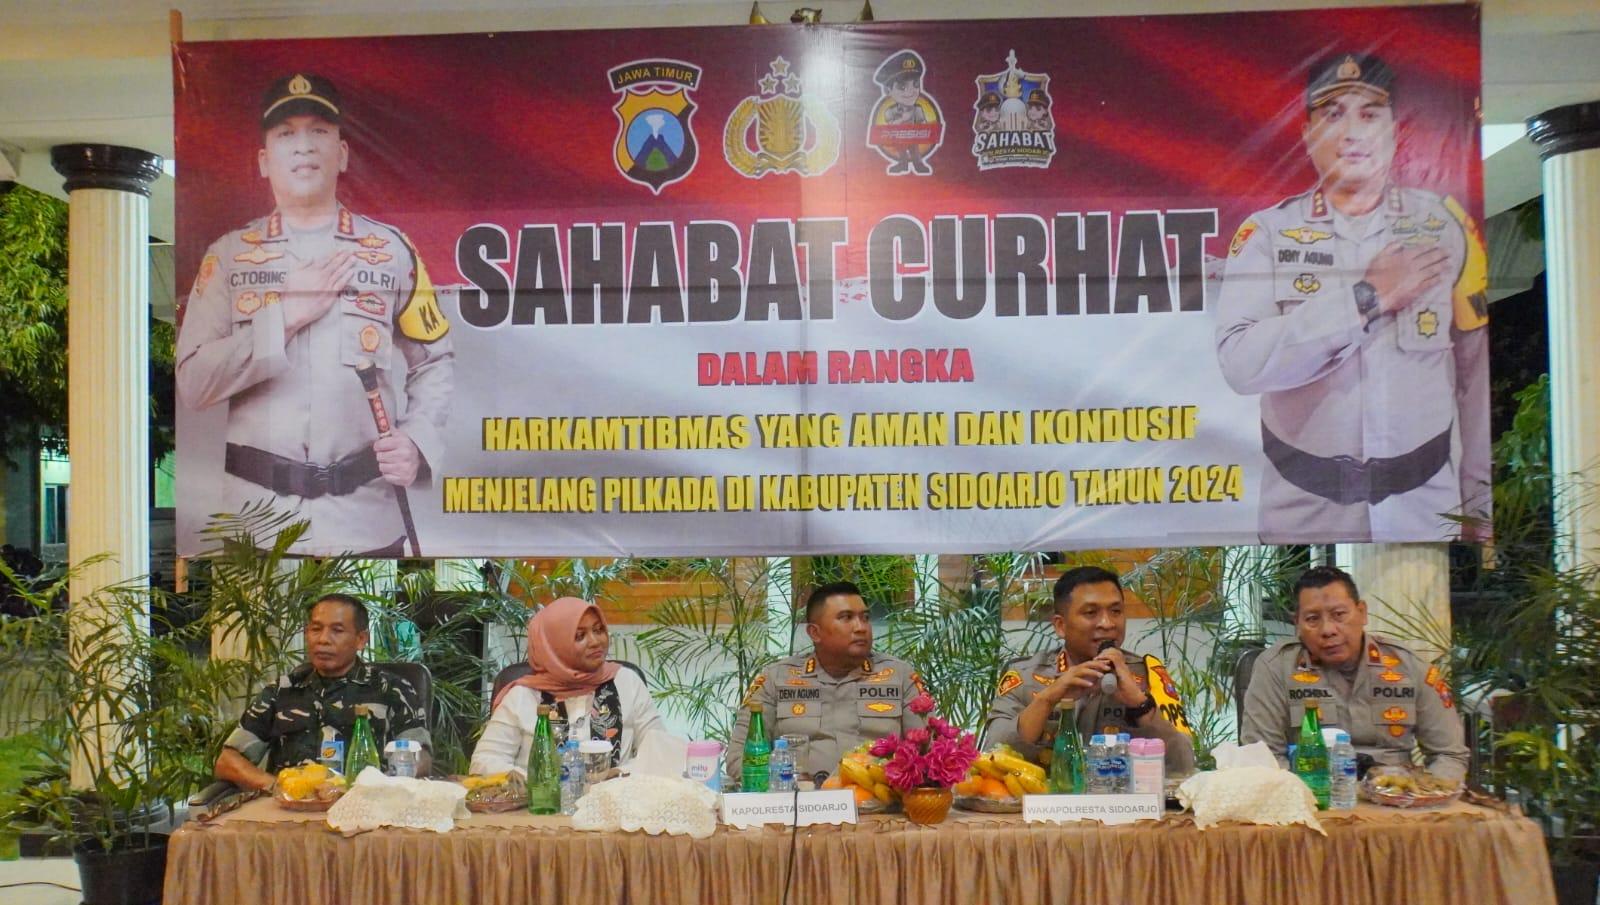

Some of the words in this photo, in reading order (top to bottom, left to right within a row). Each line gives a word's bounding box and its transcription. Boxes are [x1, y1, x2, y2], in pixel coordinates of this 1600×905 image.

[617, 68, 651, 84] JAWA
[654, 66, 694, 82] TIMUR
[975, 131, 1053, 152] SAHABAT
[456, 218, 848, 329] SAHABAT
[866, 207, 1219, 321] CURHAT
[357, 270, 396, 290] OLRI
[697, 350, 819, 386] DALAM
[827, 348, 975, 384] RANGKA
[482, 414, 752, 451] HARKAMTIBMAS
[755, 413, 844, 449] YANG
[849, 410, 949, 447] AMAN
[955, 409, 1025, 446] DAN
[1031, 405, 1200, 444] KONDUSIF
[443, 476, 597, 513] MENJELANG
[603, 475, 720, 512] PILKADA
[723, 474, 755, 512] DI
[760, 471, 922, 511] KABUPATEN
[927, 470, 1067, 510] SIDOARJO
[1072, 467, 1164, 506] TAHUN
[1168, 464, 1244, 503] 2024
[779, 688, 797, 700] DENY
[797, 688, 820, 699] AGUNG
[859, 687, 899, 698] POLRI
[1373, 687, 1416, 698] POLRI
[731, 805, 796, 816] KAPOLRESTA
[798, 803, 848, 813] SIDOARJO
[1027, 806, 1106, 815] WAKAPOLRESTA
[1108, 805, 1158, 814] SIDOARJO
